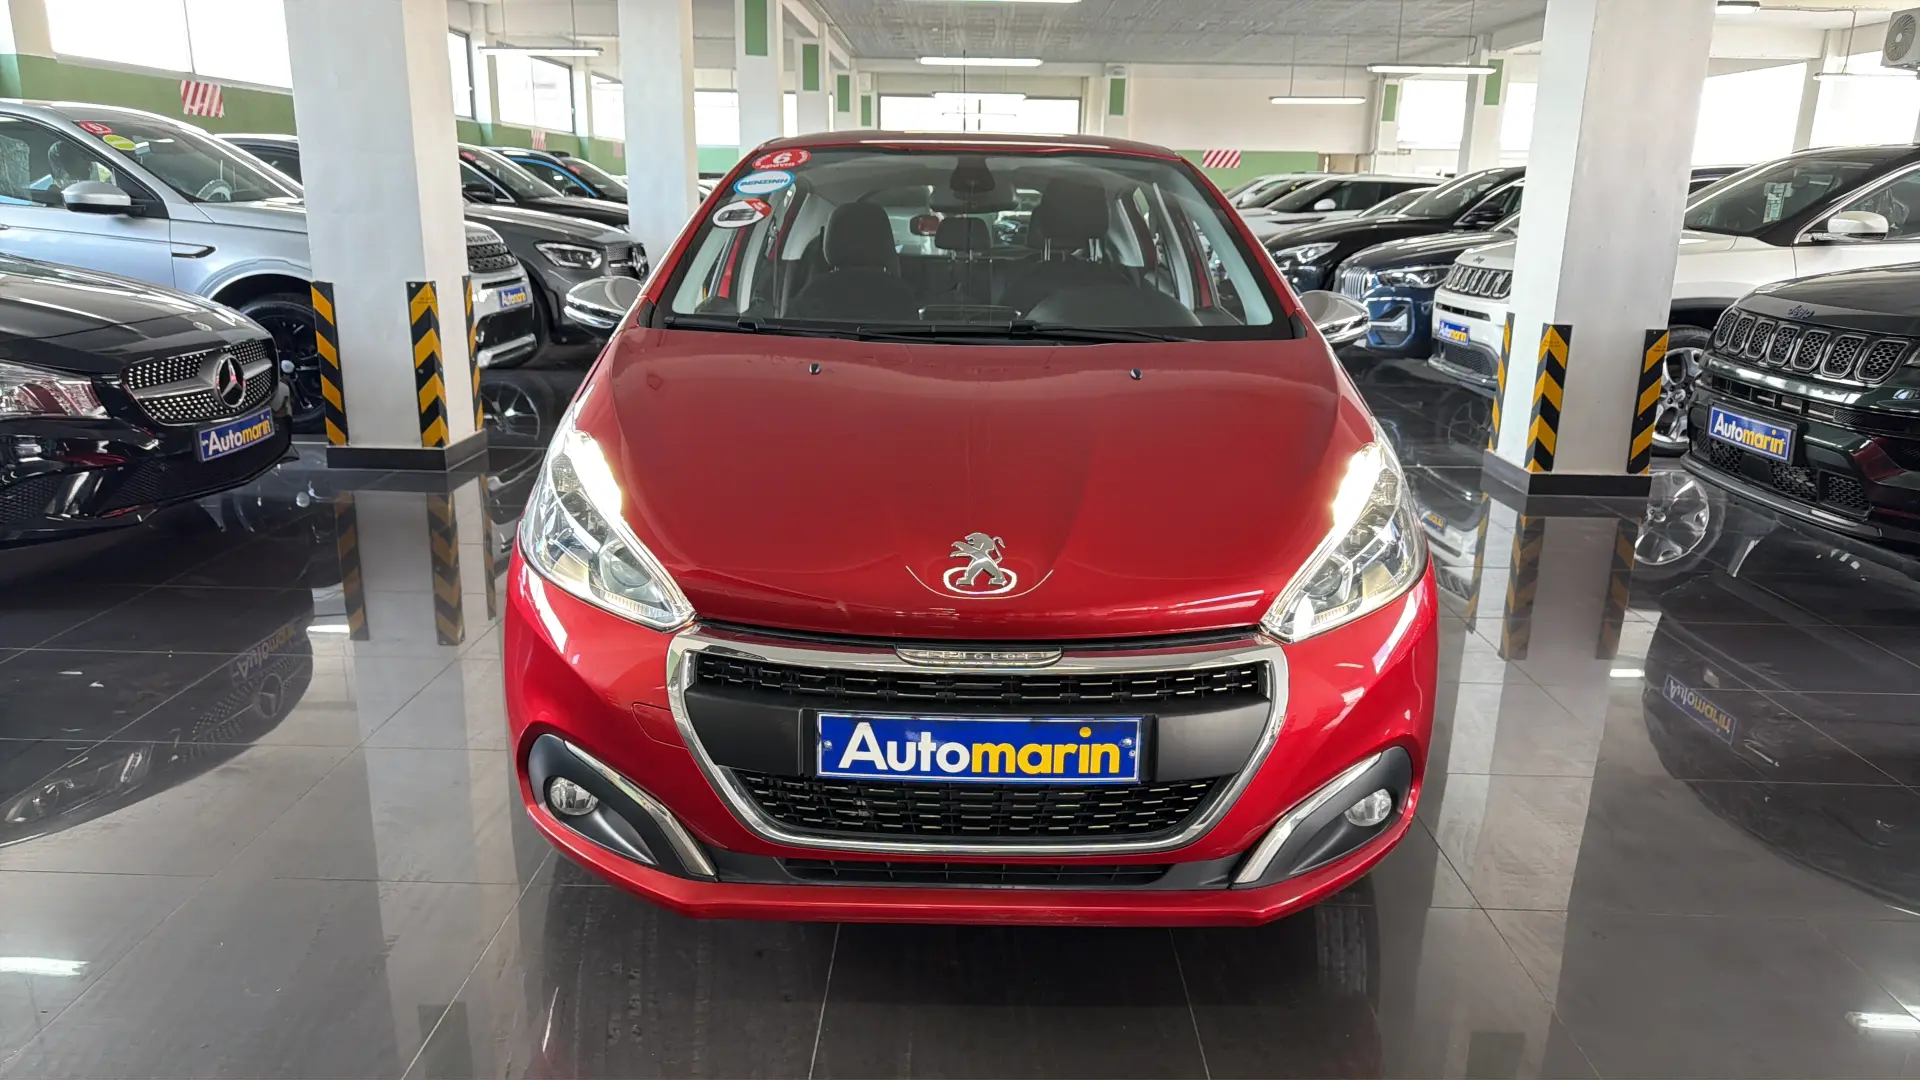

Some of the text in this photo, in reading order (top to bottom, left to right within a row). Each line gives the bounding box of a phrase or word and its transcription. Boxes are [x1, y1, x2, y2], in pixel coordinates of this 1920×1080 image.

[772, 152, 793, 165] 6
[208, 414, 271, 456] Automarin
[1713, 412, 1785, 455] Automarin
[838, 721, 1120, 774] Automarin
